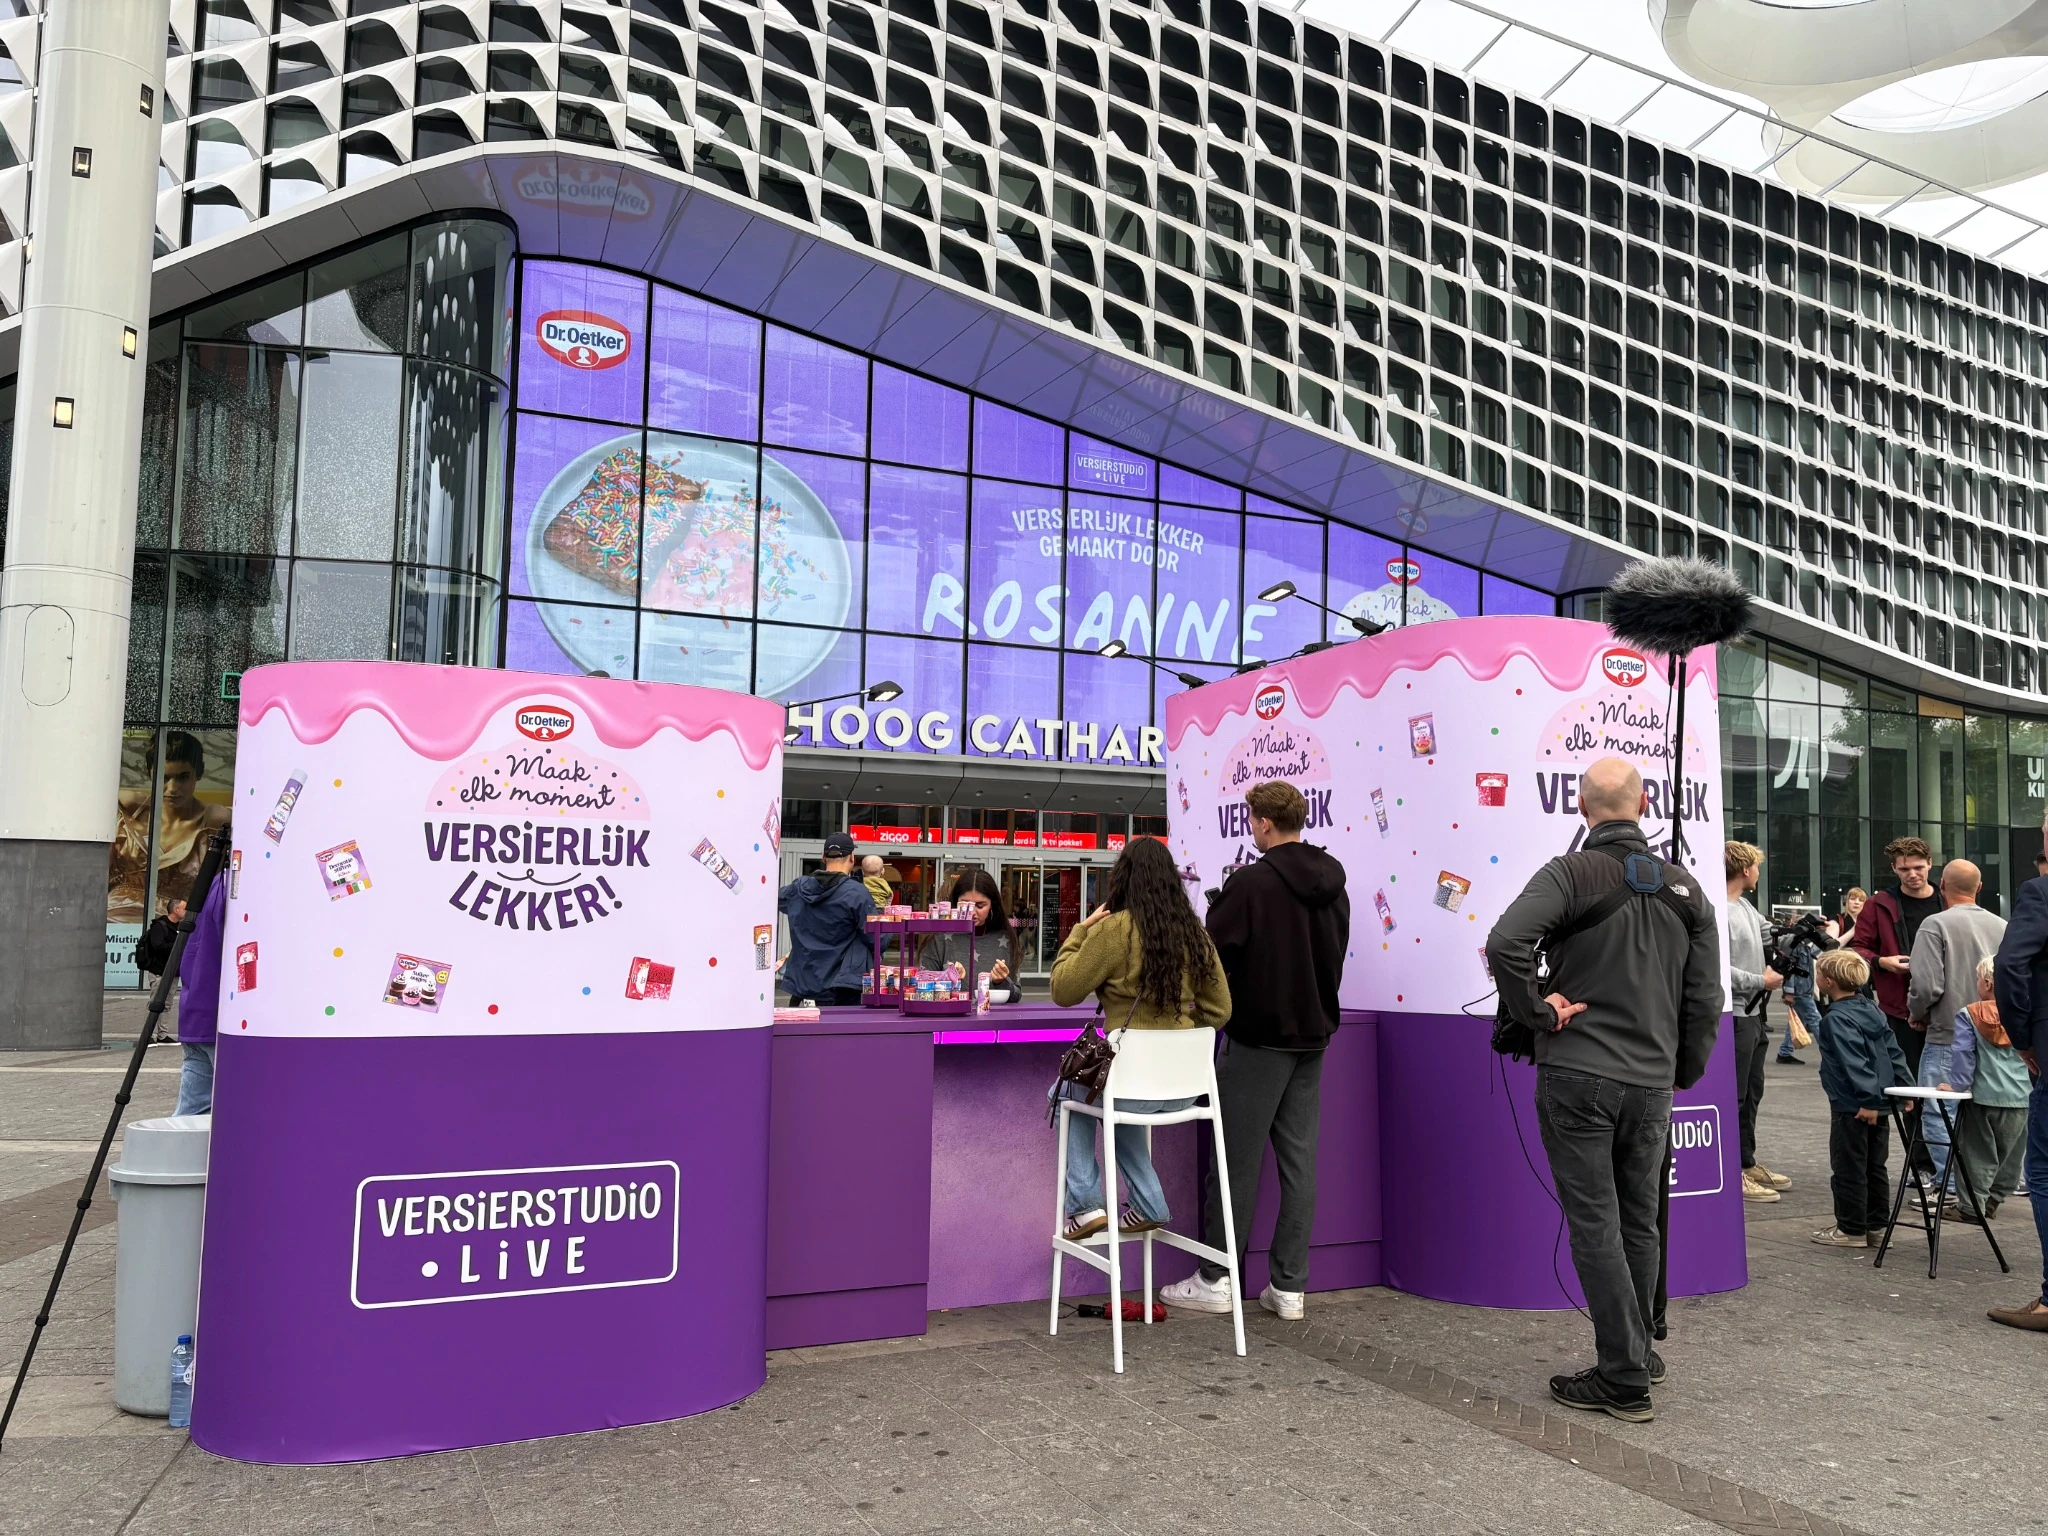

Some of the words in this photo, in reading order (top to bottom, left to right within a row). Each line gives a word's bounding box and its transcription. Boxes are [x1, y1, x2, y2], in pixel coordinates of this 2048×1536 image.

[1011, 508, 1131, 535] VERSERLiJK
[1135, 516, 1205, 555] LEKKER
[1039, 535, 1127, 560] GEMAAKT
[1130, 542, 1180, 573] DOOR
[922, 572, 1278, 664] ROSANNE
[1605, 658, 1644, 673] Dr.Oetker
[521, 714, 570, 728] Dr.Oetker
[788, 701, 954, 749] HOOG
[1598, 700, 1664, 731] Maak
[1251, 731, 1296, 757] Maak
[1565, 723, 1598, 751] elk
[1603, 733, 1678, 760] moment
[506, 754, 591, 783] Maak
[1232, 760, 1252, 785] elk
[1254, 750, 1311, 779] moment
[460, 776, 501, 803] elk
[509, 784, 616, 809] moment
[448, 870, 623, 932] LEKKER!
